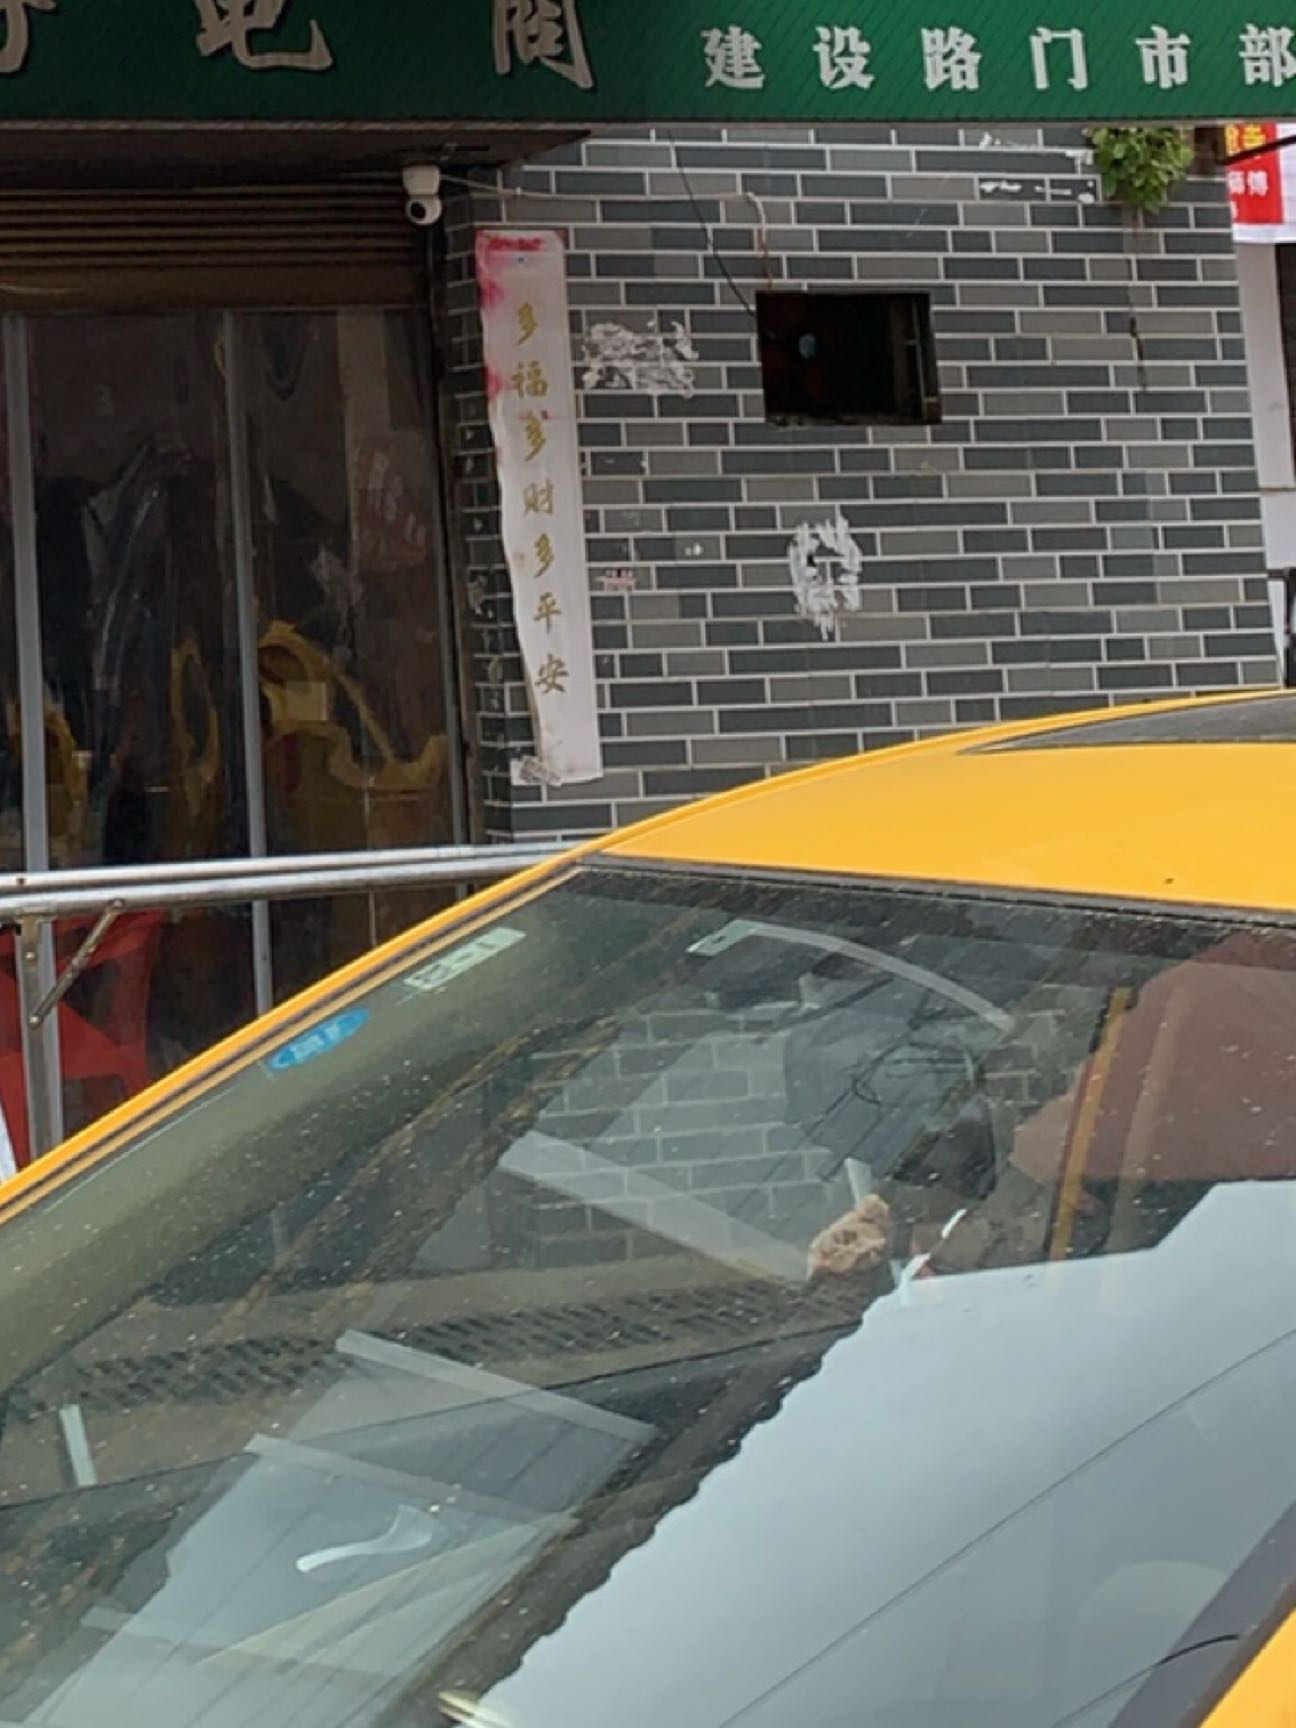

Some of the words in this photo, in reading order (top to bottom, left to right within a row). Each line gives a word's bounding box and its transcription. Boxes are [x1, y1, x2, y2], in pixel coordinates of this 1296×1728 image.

[700, 24, 1296, 91] 建设路门市部
[510, 301, 569, 695] 多福多财多平安
